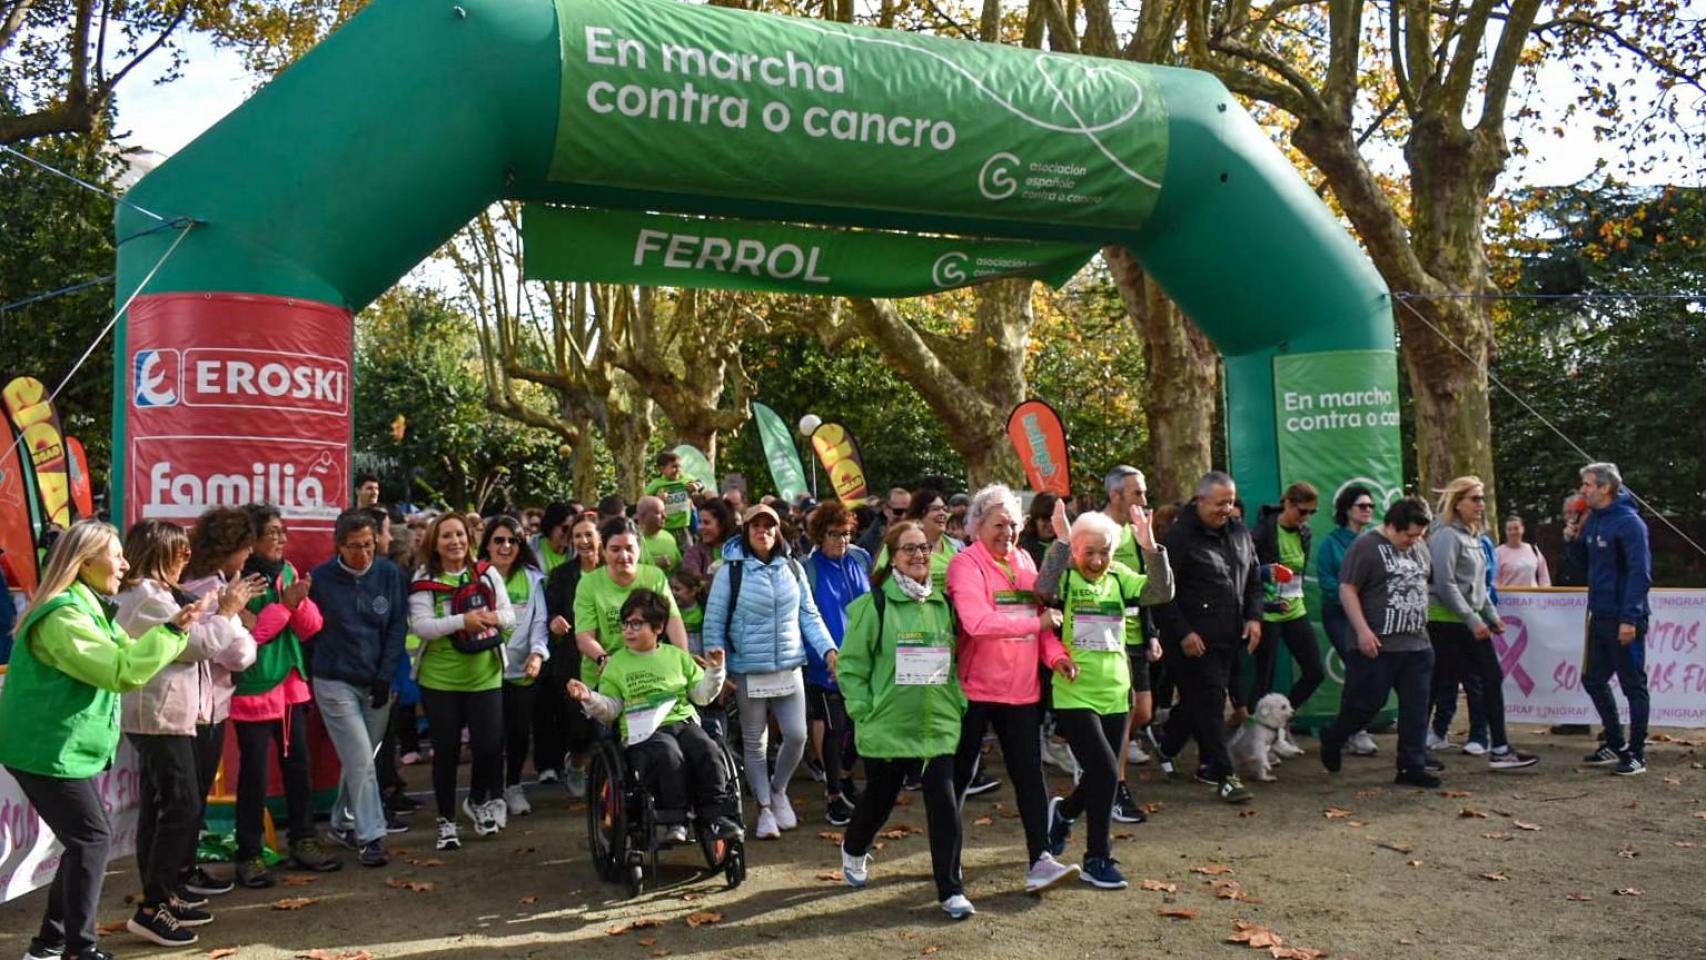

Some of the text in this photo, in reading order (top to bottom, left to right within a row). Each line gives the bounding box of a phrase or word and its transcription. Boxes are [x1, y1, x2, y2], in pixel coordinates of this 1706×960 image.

[585, 26, 844, 94] En marcha
[586, 80, 956, 151] contra o cancro
[633, 229, 831, 283] FERROL
[196, 360, 343, 404] EROSKI
[1284, 386, 1392, 411] En marcha
[1286, 410, 1361, 432] contra
[1366, 411, 1377, 427] o
[150, 462, 325, 508] familia
